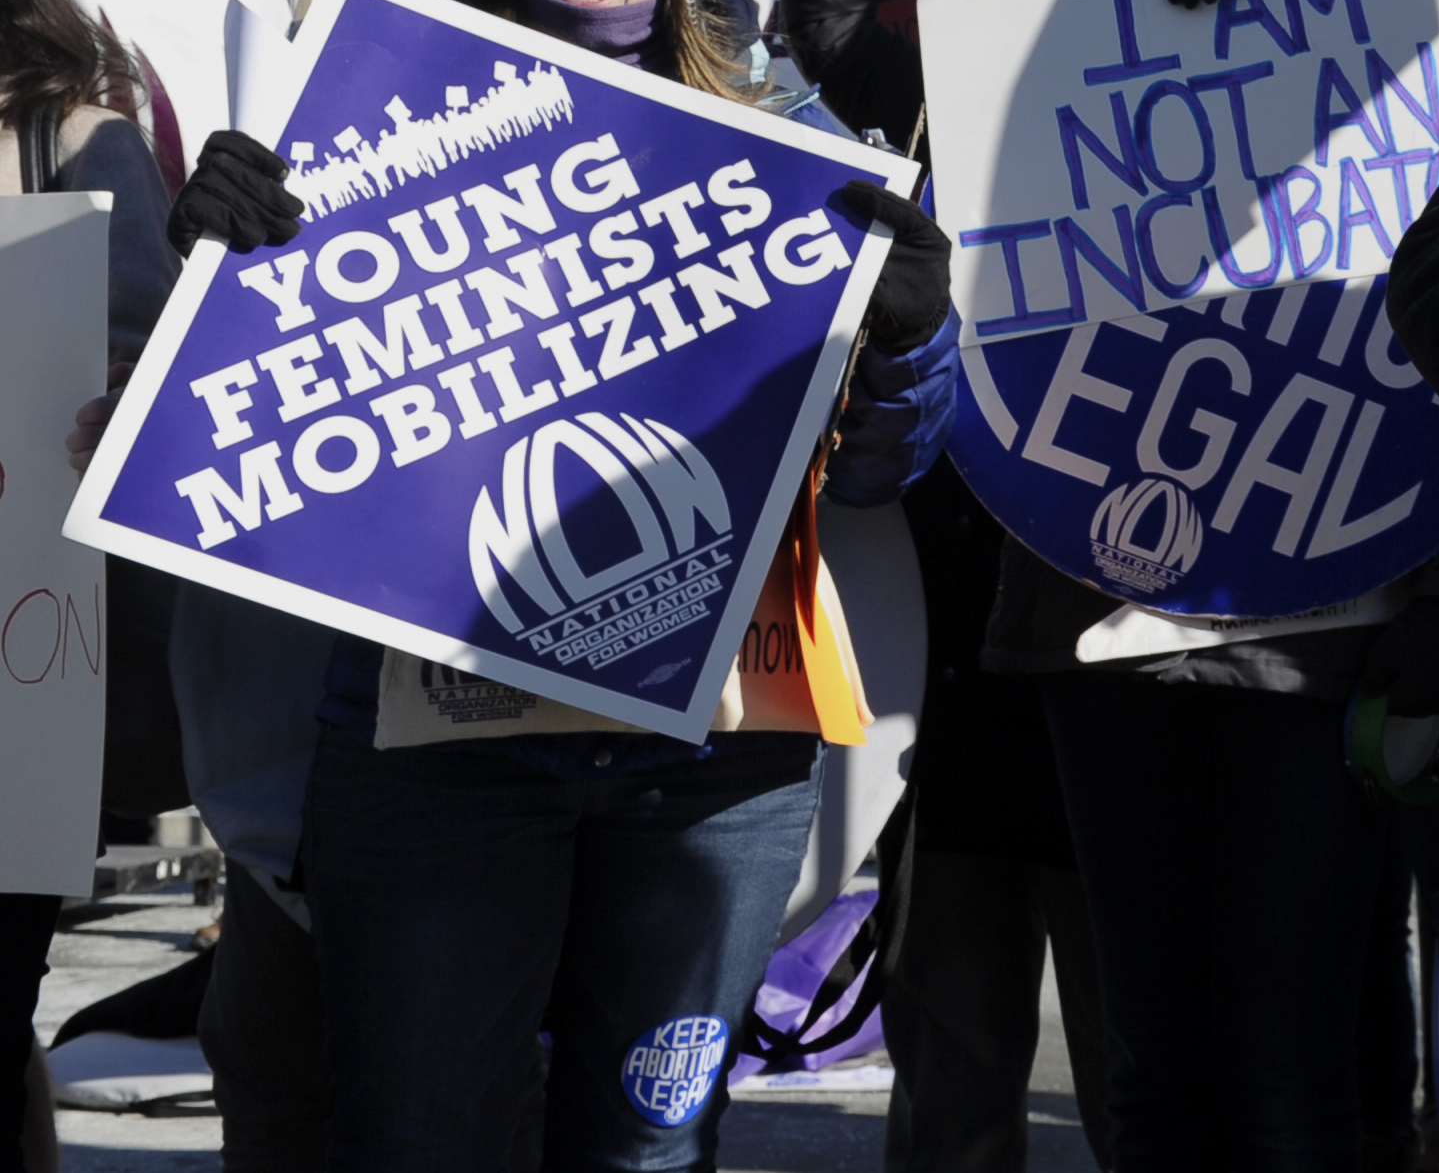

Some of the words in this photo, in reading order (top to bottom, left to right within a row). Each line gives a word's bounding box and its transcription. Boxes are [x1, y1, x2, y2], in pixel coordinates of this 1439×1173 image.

[1055, 59, 1275, 211] NOT
[237, 131, 641, 333] YOUNG
[189, 158, 774, 451] FEMINISTS
[174, 208, 854, 551] MOBILIZING
[468, 411, 732, 635] NOW
[1089, 478, 1203, 574] NOW
[1092, 544, 1178, 582] NATIONAL
[2, 583, 101, 684] ON
[527, 548, 730, 652] NATIONAL
[554, 573, 721, 662] ORGANIZATION
[586, 640, 628, 668] FOR
[628, 600, 708, 644] WOMEN
[427, 686, 531, 703] NATION
[627, 1035, 726, 1081] ABORTION
[653, 1016, 721, 1049] KEEP
[634, 1073, 712, 1111] LEGAL
